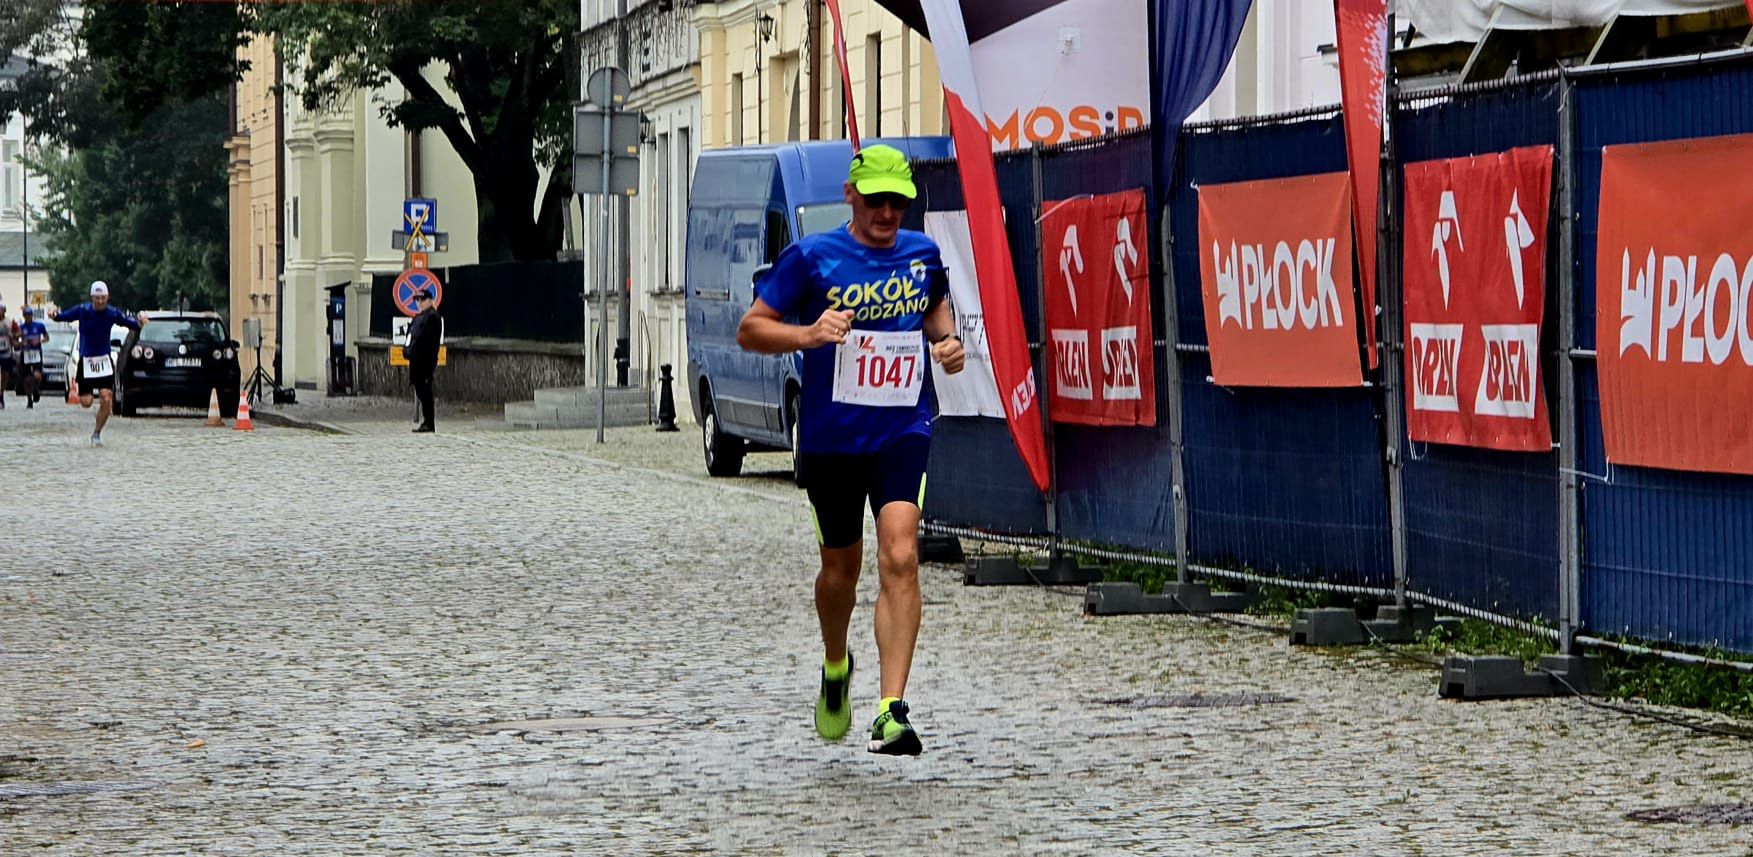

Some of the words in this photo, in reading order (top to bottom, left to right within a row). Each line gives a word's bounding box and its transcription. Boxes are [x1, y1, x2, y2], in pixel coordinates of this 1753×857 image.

[827, 269, 921, 310] SOKÓŁ
[1241, 238, 1344, 331] PŁOCK
[851, 291, 929, 321] ODZANÓ
[856, 354, 915, 388] 1047
[1053, 339, 1089, 388] RLEN
